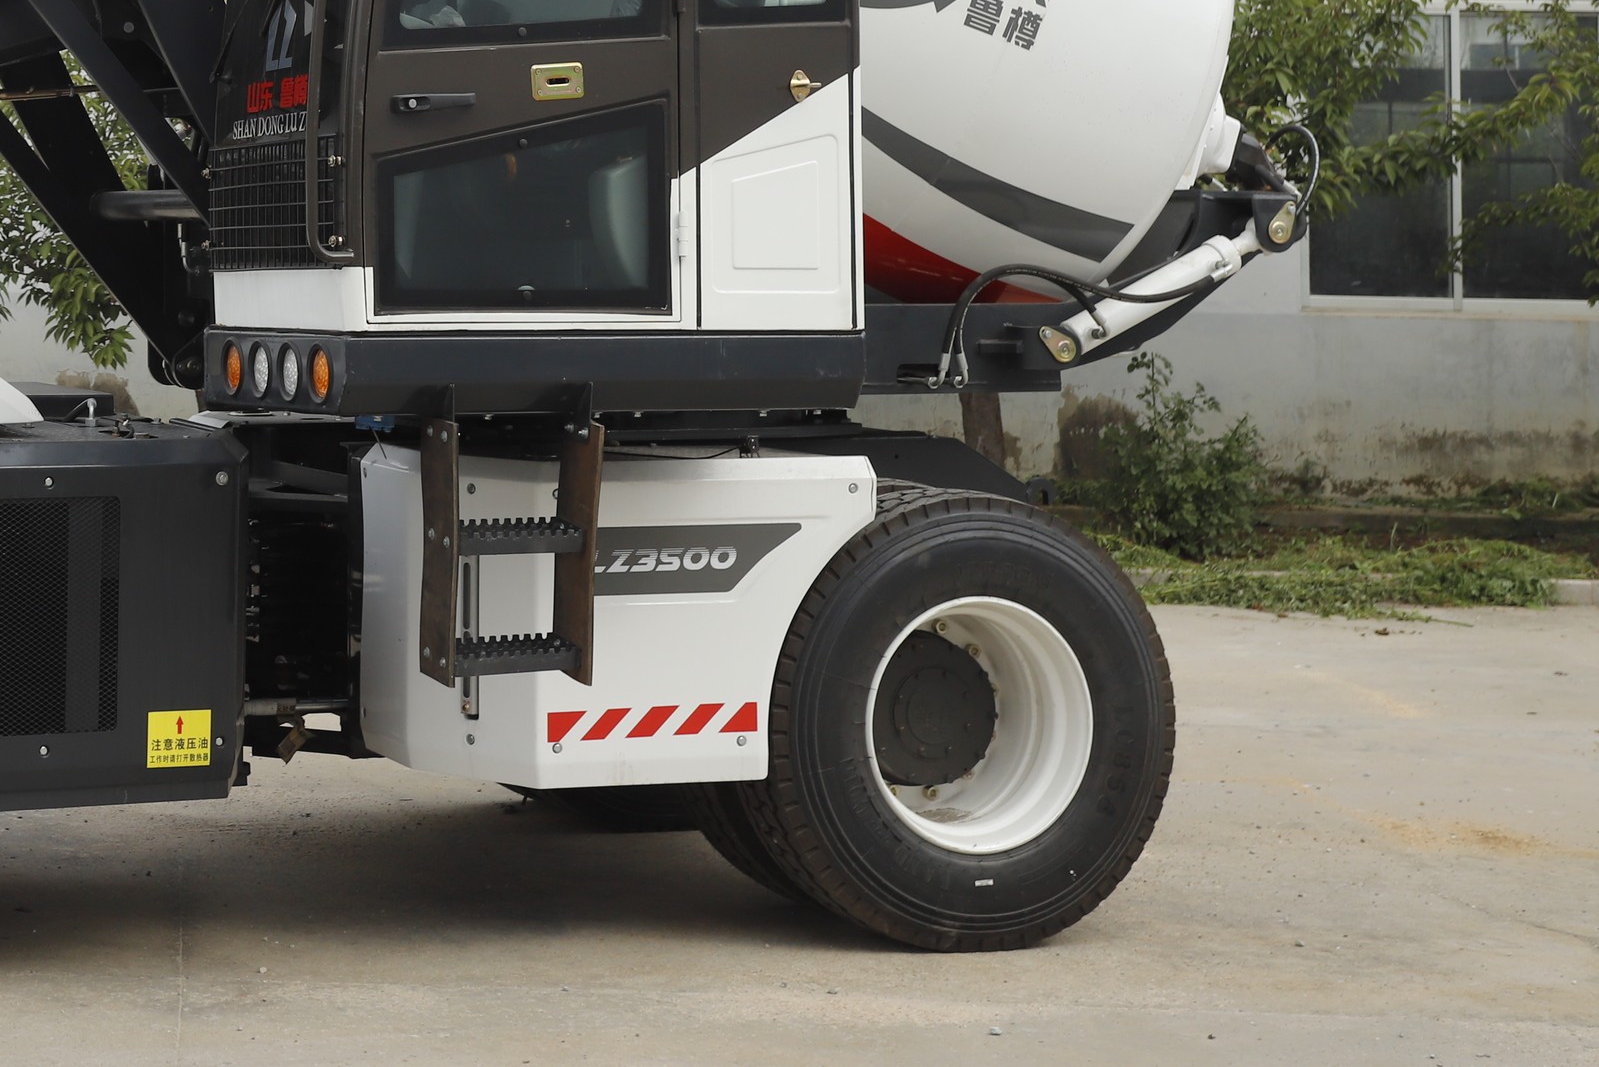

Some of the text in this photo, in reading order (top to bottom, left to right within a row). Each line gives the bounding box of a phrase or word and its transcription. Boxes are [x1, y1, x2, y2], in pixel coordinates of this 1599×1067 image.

[232, 116, 258, 140] SHAN
[257, 113, 284, 137] DONG
[151, 737, 209, 751] 注意液压油
